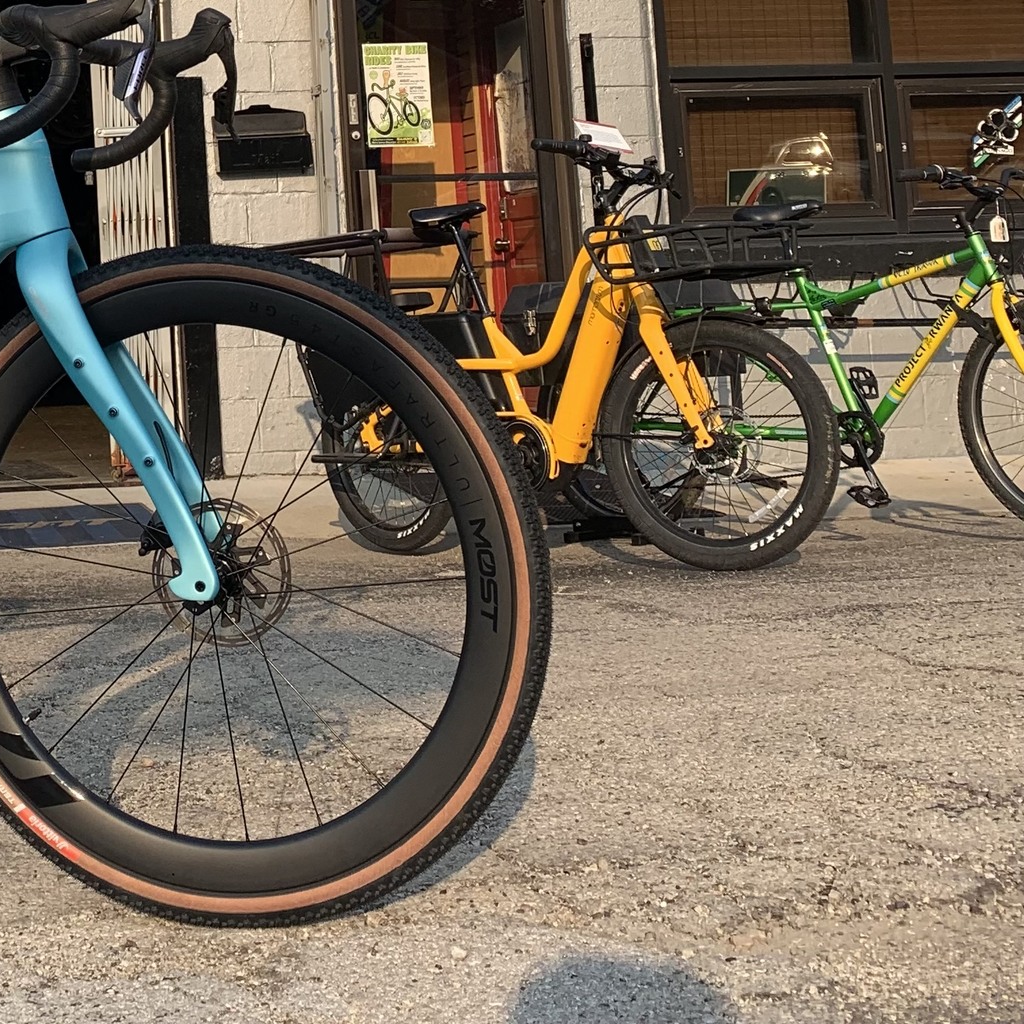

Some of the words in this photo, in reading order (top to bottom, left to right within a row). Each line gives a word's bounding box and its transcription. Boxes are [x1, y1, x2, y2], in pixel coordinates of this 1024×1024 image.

[364, 56, 392, 66] RIDES
[405, 45, 427, 55] BIKE
[894, 345, 927, 388] PROJECT
[929, 294, 963, 338] RWANA
[749, 503, 804, 551] MAXXIS
[469, 518, 499, 633] MOST
